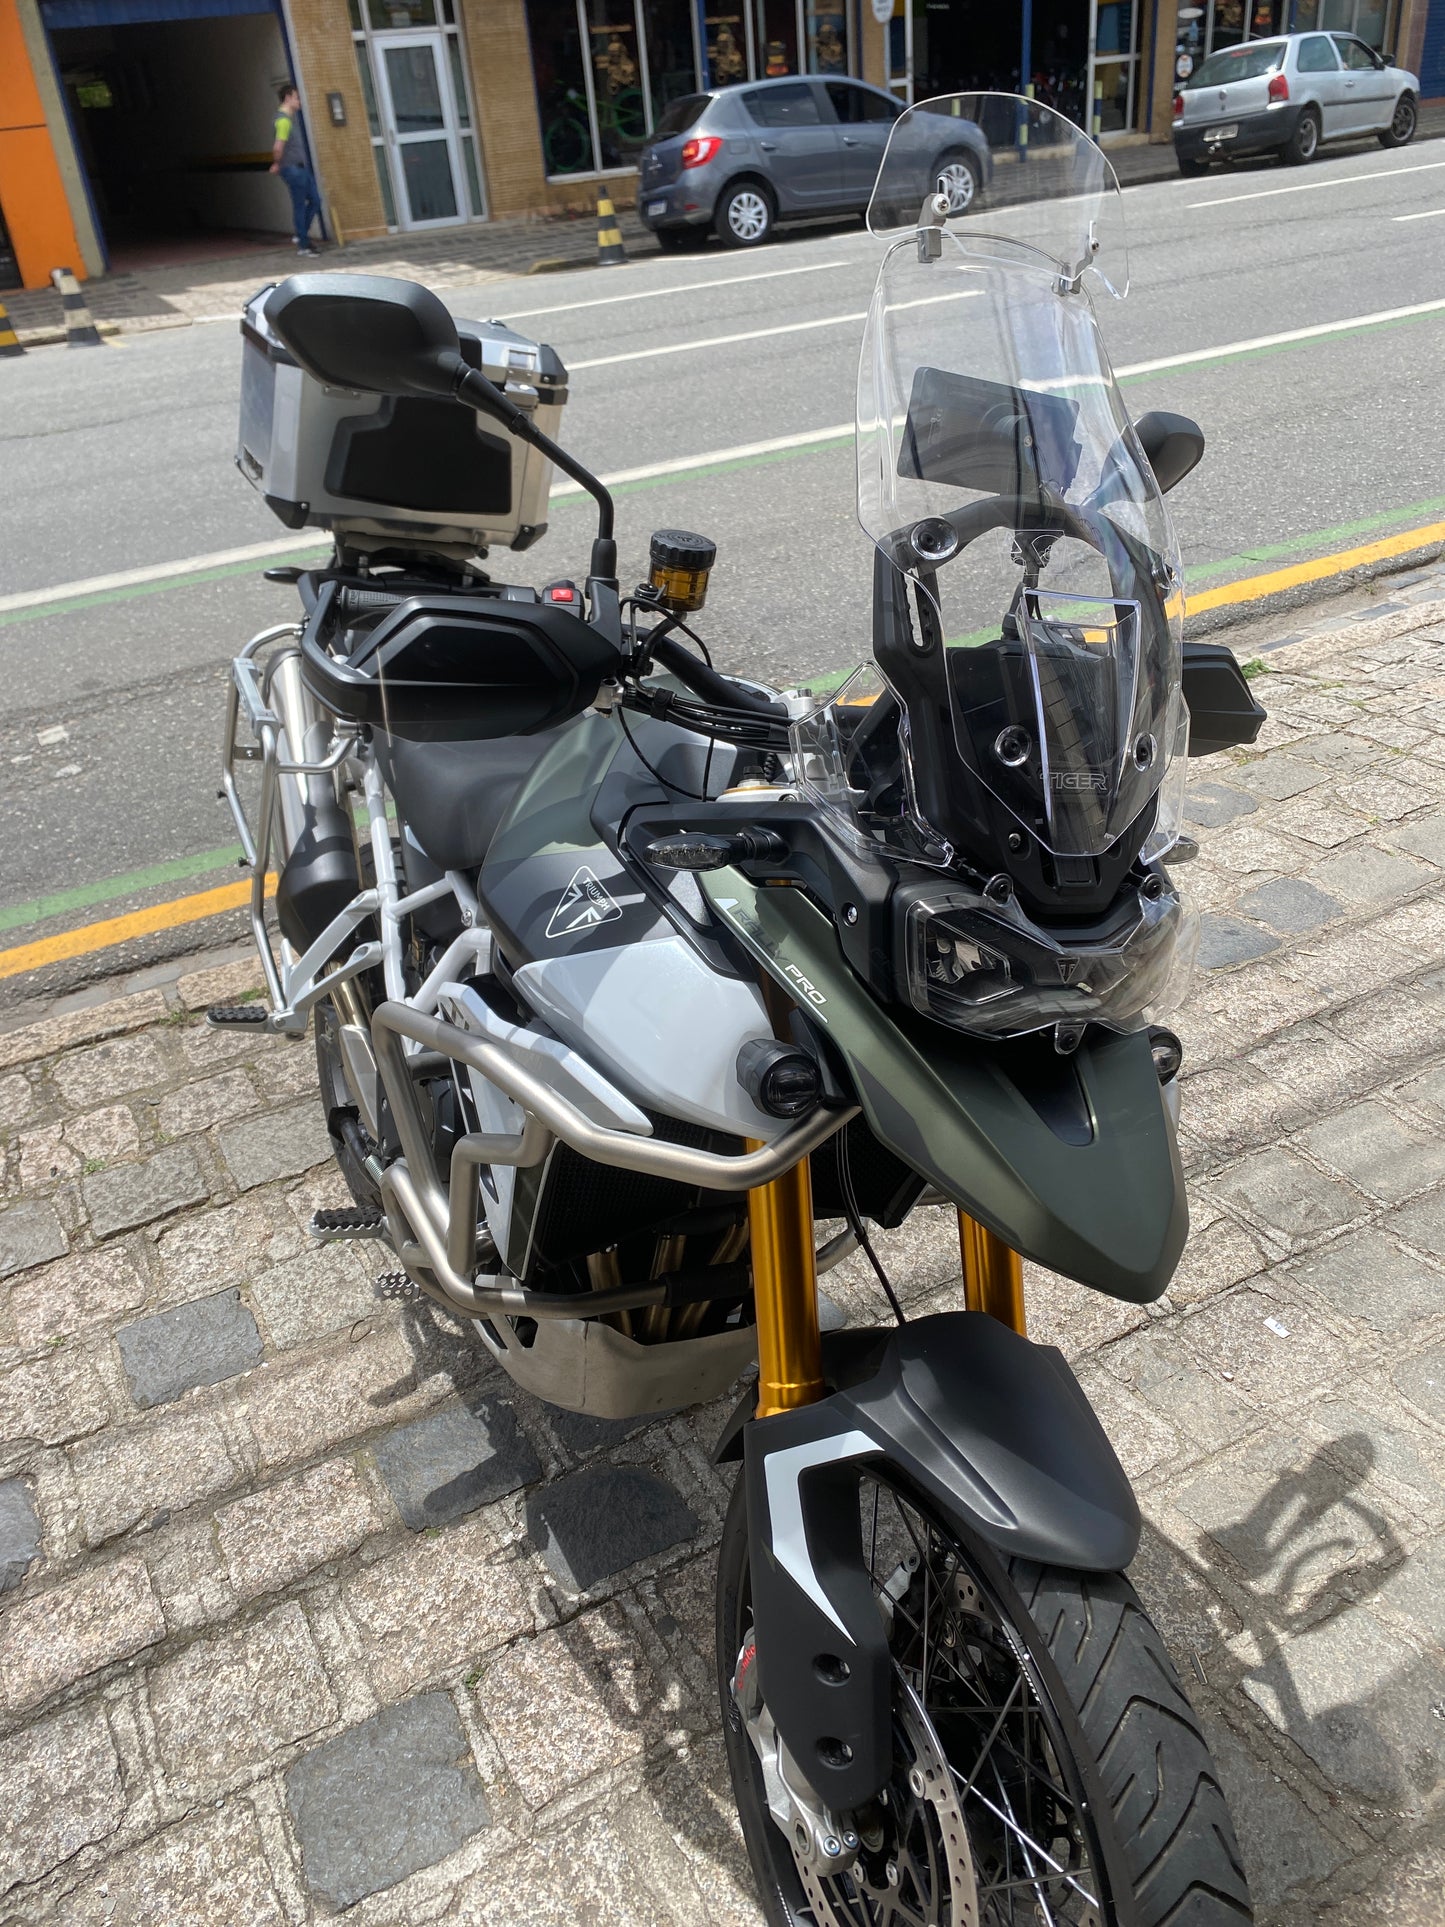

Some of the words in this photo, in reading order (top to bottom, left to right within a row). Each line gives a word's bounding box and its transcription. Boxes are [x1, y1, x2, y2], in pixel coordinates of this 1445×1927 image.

[1040, 771, 1107, 790] TIGER
[582, 877, 610, 911] TRIUMPH
[784, 963, 827, 1005] PRO
[737, 1644, 756, 1690] bmbo
